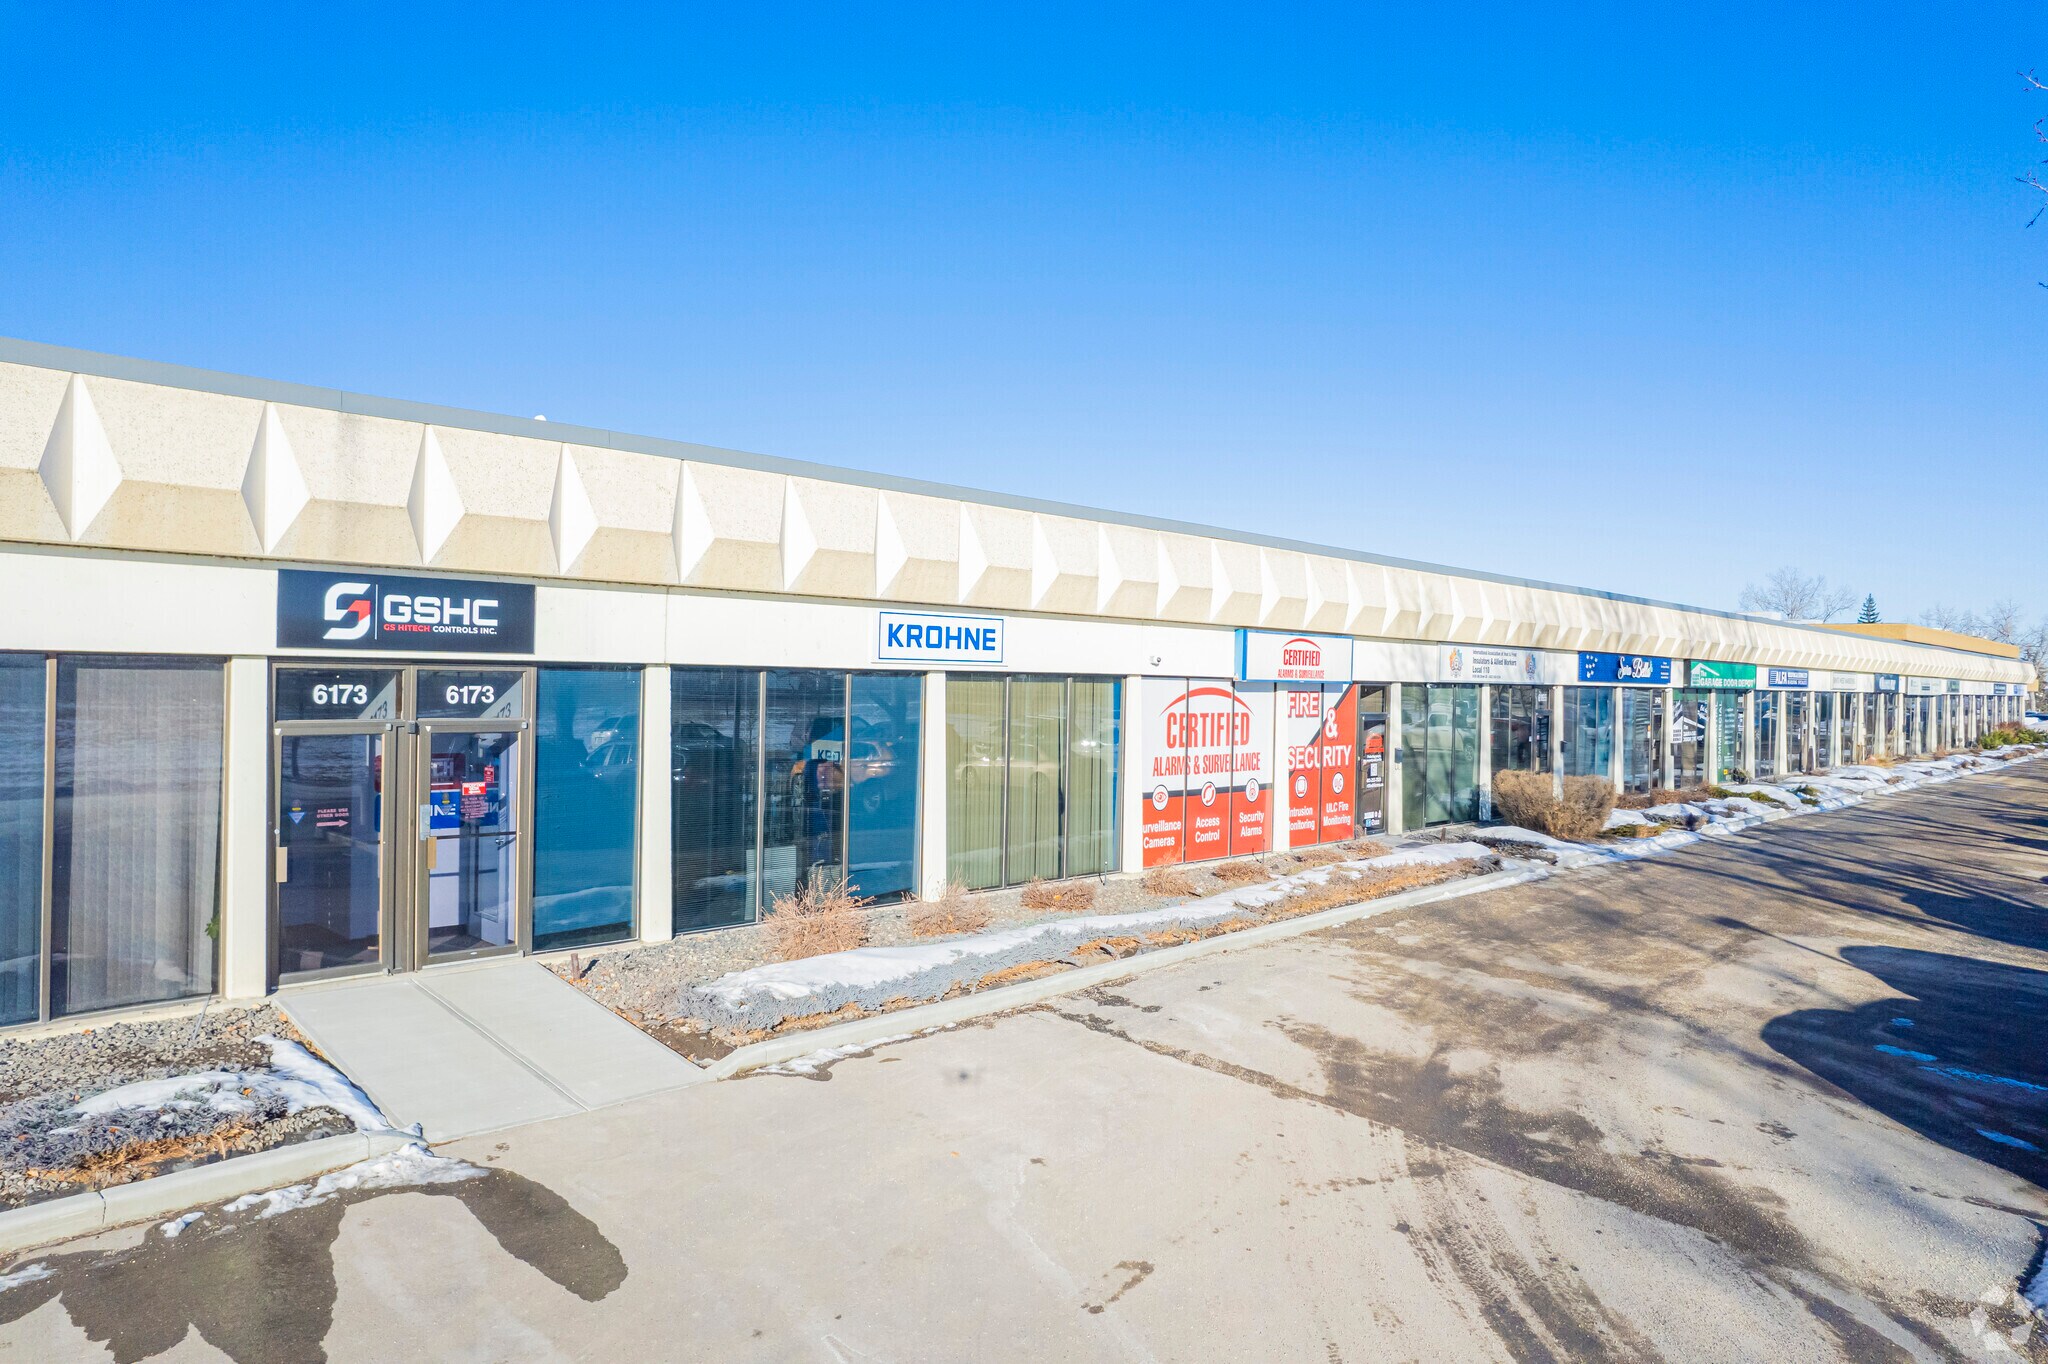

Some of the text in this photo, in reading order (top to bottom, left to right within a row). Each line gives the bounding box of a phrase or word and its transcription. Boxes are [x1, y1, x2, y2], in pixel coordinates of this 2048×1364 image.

[383, 594, 499, 626] GSHC
[383, 623, 497, 635] GS HITECH CONTROLS INC.
[887, 623, 996, 651] KROHNE
[1283, 648, 1321, 667] CERTIFIED
[1701, 677, 1723, 687] GARAGE
[1723, 678, 1738, 687] DOOR
[313, 684, 368, 704] 6173
[446, 685, 495, 704] 6173
[1287, 690, 1320, 718] FIRE
[1325, 706, 1339, 739] &
[1166, 712, 1250, 749] CERTIFIED
[1287, 744, 1352, 770] SECURITY
[1152, 755, 1191, 777] ALARMS
[1193, 755, 1201, 775] &
[1338, 801, 1349, 811] Fire
[1195, 817, 1220, 828] Access
[1239, 811, 1264, 823] Security
[1323, 815, 1351, 826] Monitoring
[1142, 820, 1181, 833] urveillance
[1240, 825, 1262, 837] Alarms
[1289, 818, 1316, 831] onitoring
[1143, 836, 1175, 849] Cameras
[1195, 829, 1220, 843] Control
